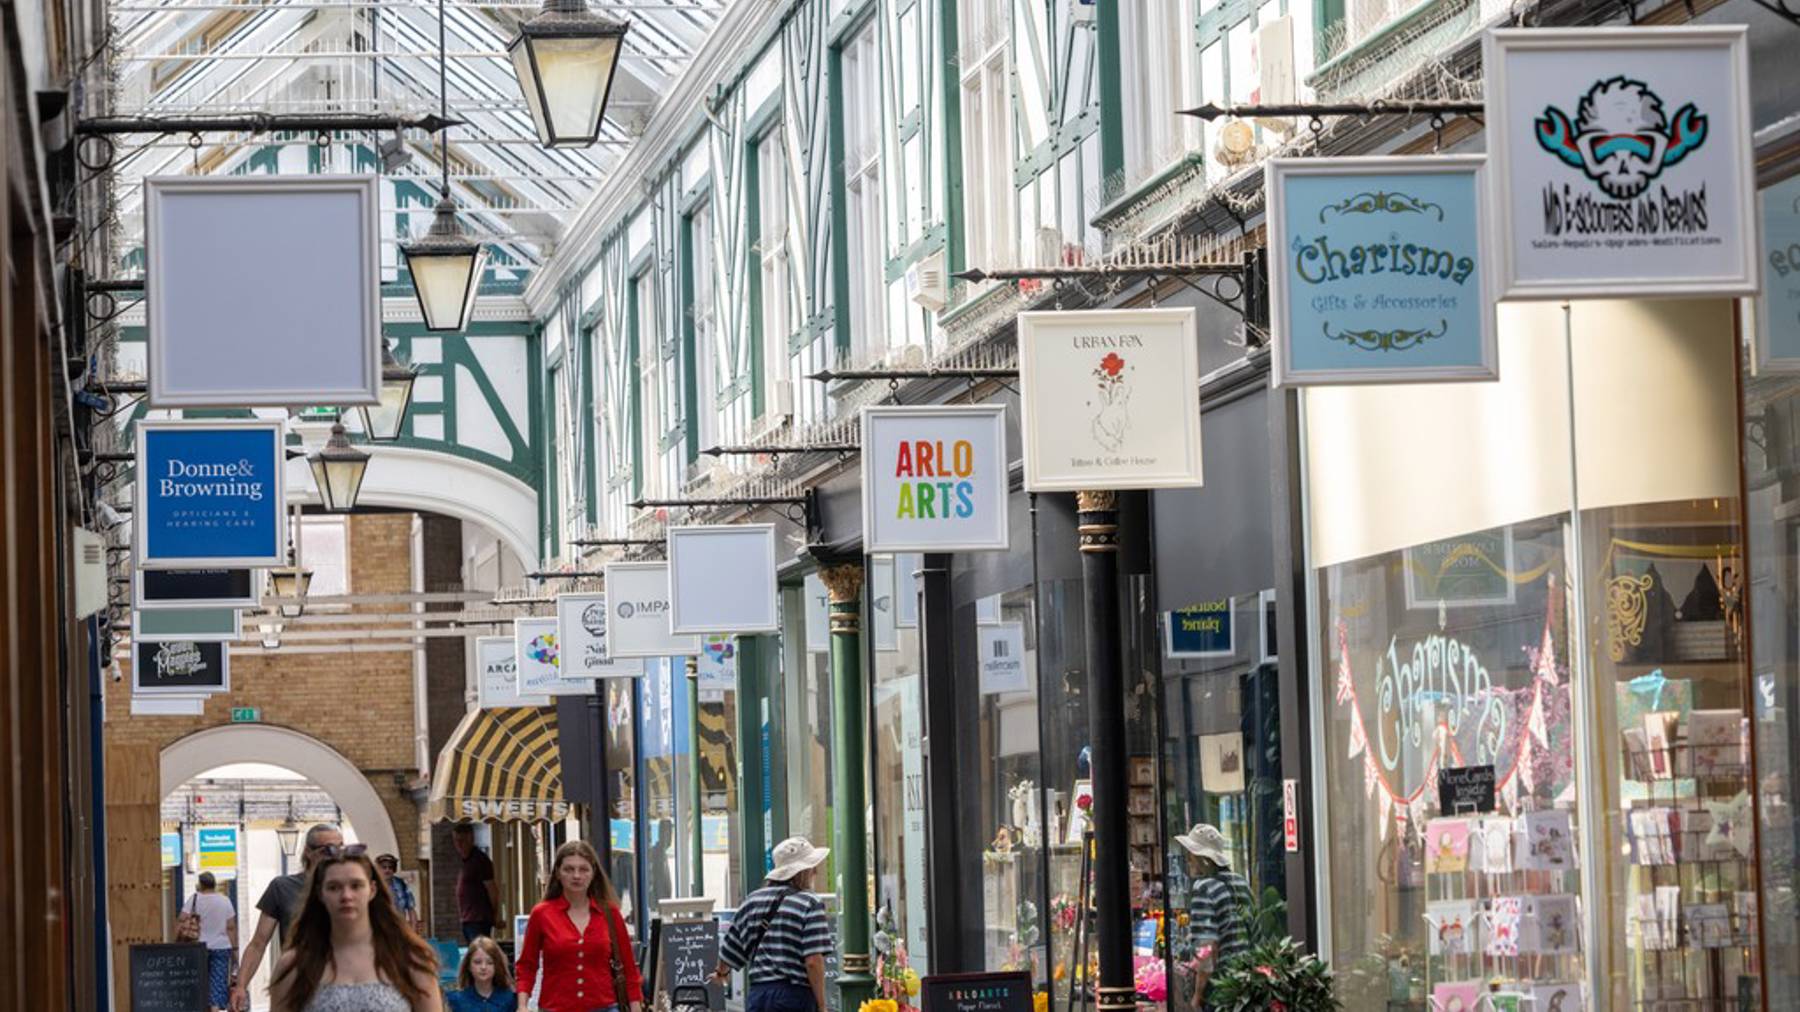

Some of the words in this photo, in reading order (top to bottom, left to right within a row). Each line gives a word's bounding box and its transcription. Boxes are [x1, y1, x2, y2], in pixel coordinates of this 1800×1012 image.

[1296, 233, 1475, 287] Charisma
[1311, 294, 1348, 314] Gifts
[1353, 294, 1367, 310] &
[1371, 293, 1458, 311] Accessories
[1073, 335, 1116, 349] URBAN
[1118, 334, 1143, 348] FOX
[167, 458, 254, 478] Donne&
[895, 439, 975, 478] ARLO
[159, 477, 263, 501] Browning
[896, 481, 975, 519] ARTS
[165, 519, 220, 528] HEARING
[225, 519, 256, 528] CARE
[171, 510, 238, 518] OPTICIANS
[462, 800, 569, 816] SWEETS
[146, 957, 186, 969] OPEN
